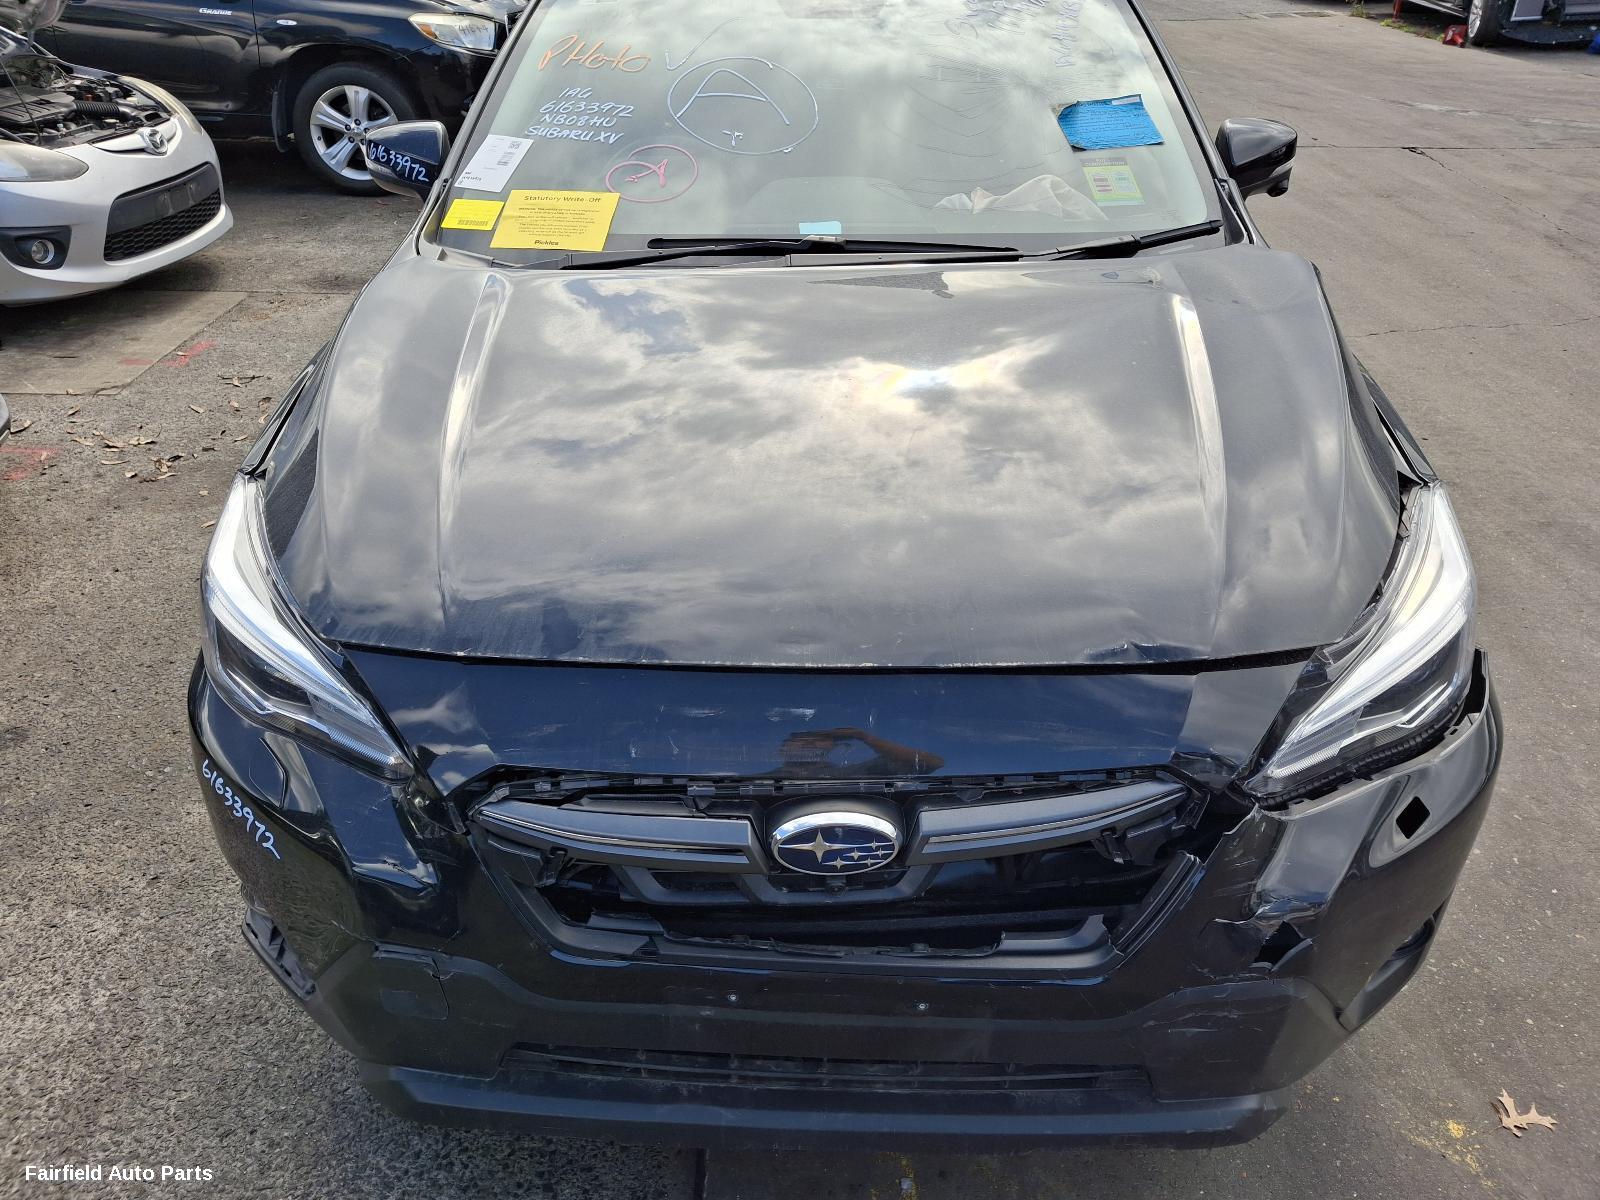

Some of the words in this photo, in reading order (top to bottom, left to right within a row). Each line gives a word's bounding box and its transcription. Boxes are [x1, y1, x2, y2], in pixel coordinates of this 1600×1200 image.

[540, 100, 634, 117] 61633972
[525, 125, 594, 141] SUBARU
[594, 131, 624, 144] XV
[369, 142, 429, 182] 61633972
[202, 759, 281, 859] 61633972
